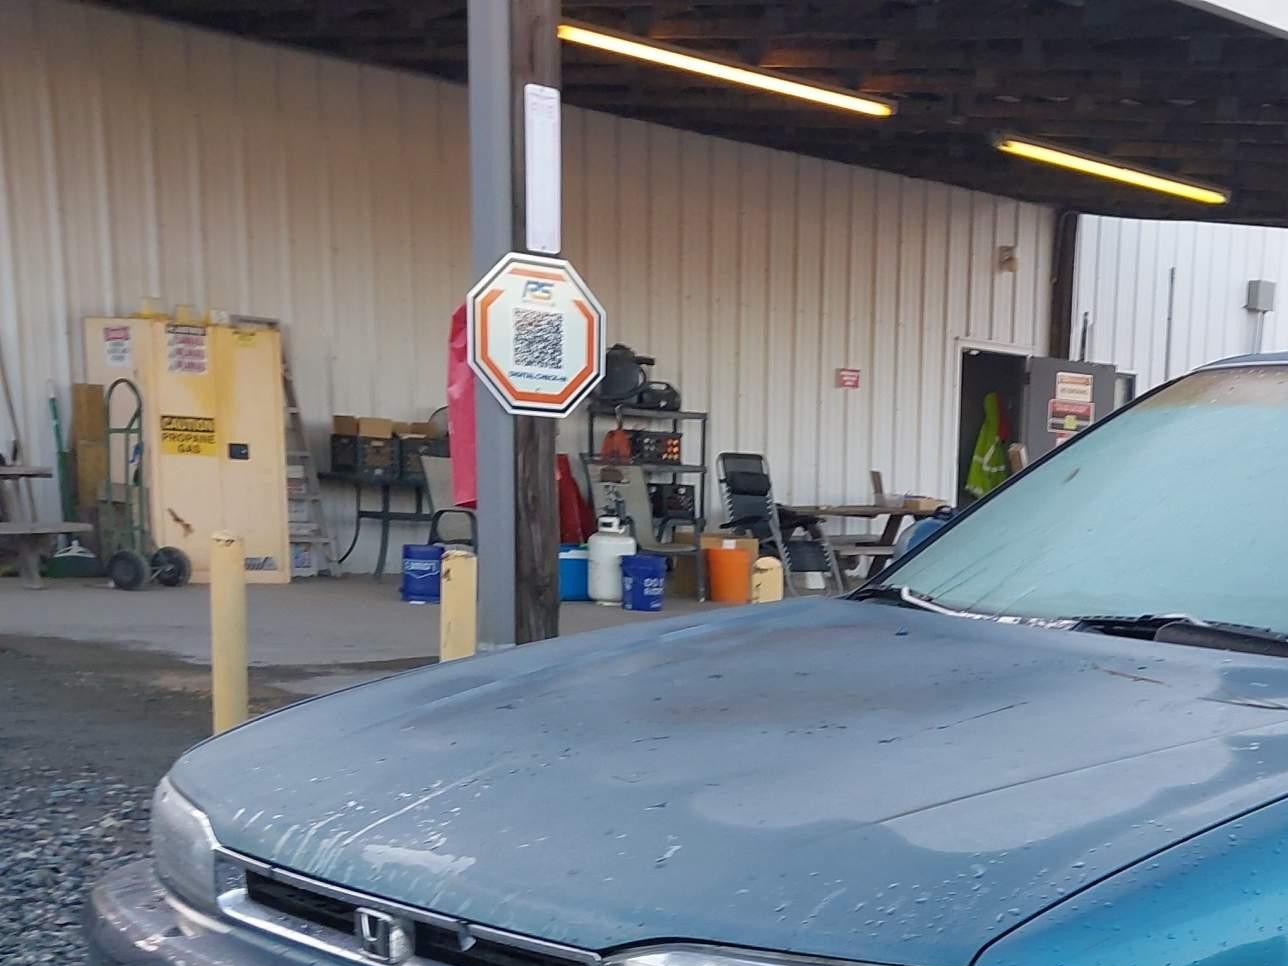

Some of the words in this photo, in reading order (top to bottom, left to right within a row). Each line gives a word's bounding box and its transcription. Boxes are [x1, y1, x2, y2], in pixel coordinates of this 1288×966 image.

[161, 416, 215, 432] CAUTION
[161, 432, 216, 444] PROPANE
[177, 444, 201, 454] GAS
